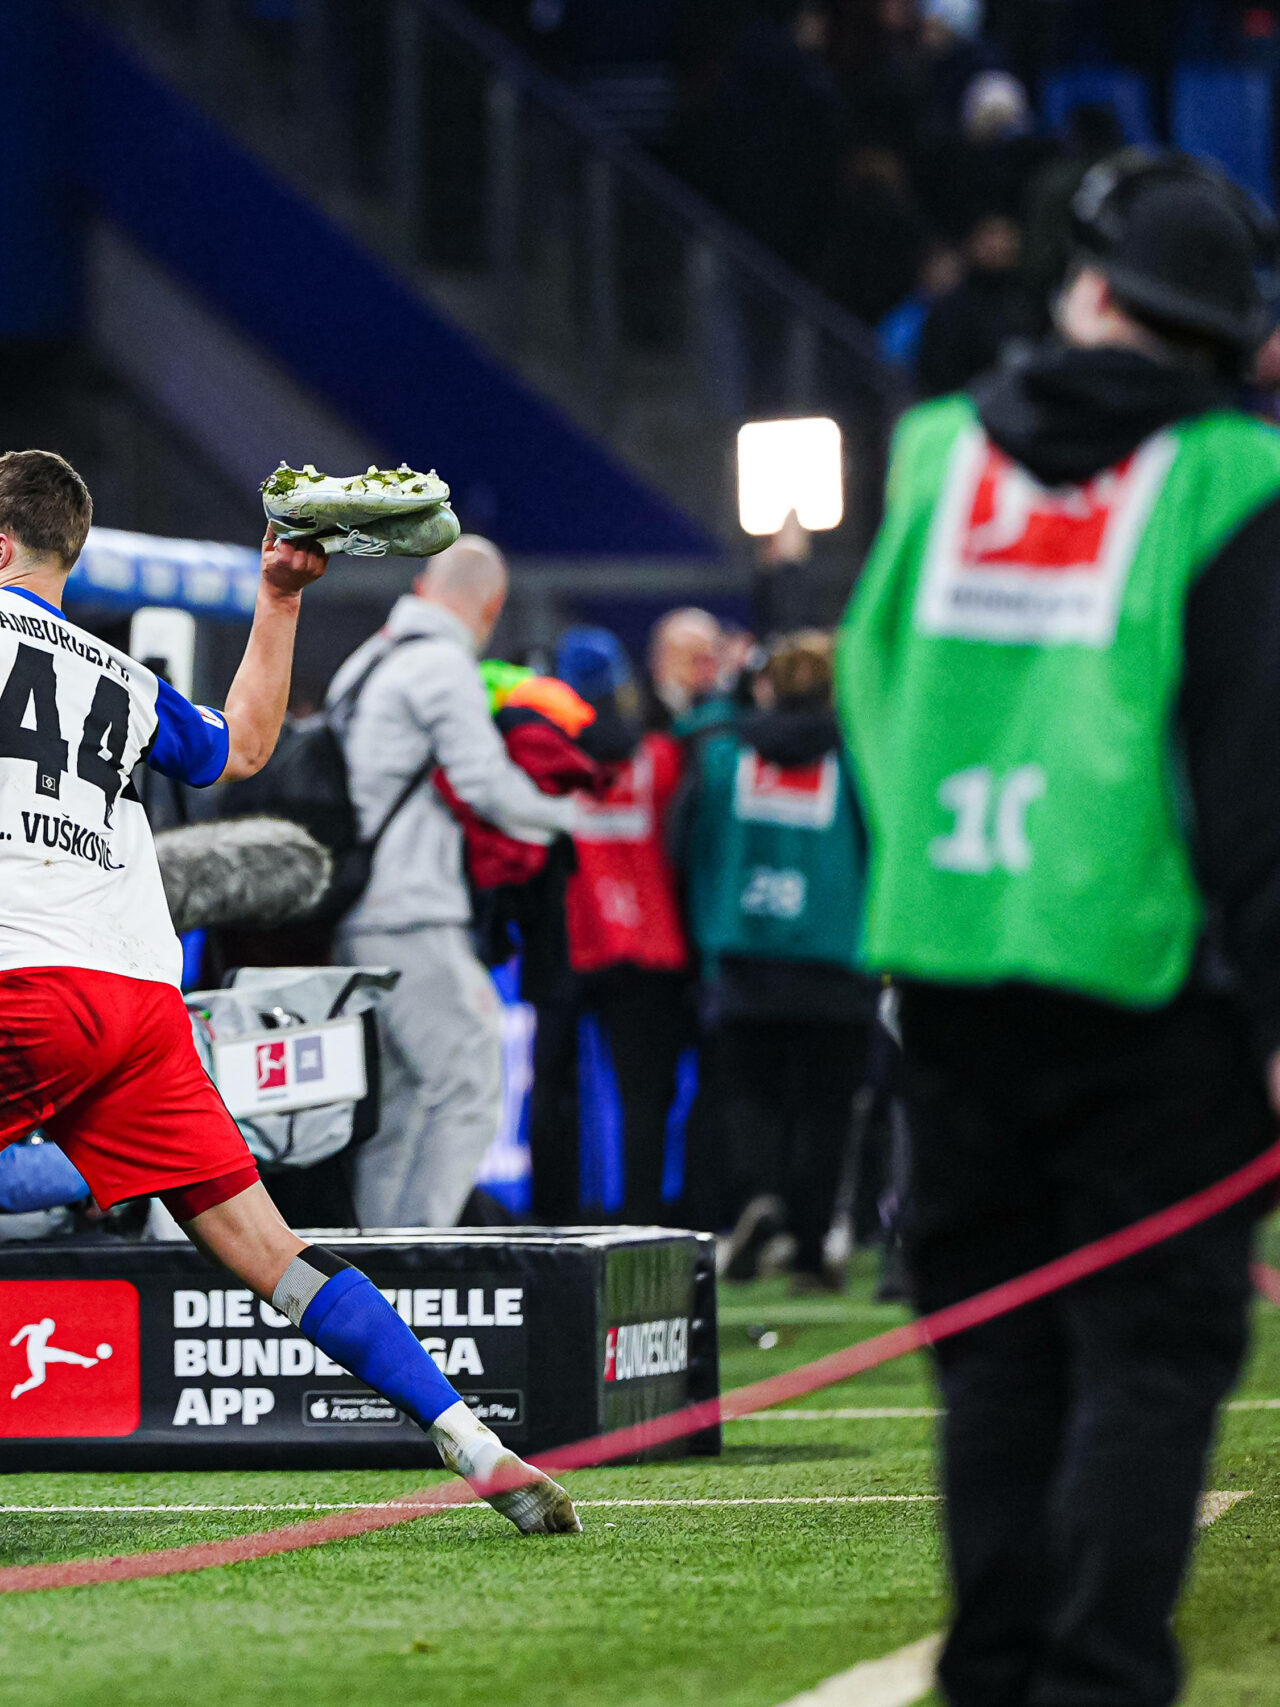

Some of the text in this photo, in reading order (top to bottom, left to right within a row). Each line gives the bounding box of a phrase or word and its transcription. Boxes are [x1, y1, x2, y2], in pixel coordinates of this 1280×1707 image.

[173, 1289, 255, 1329] DIE
[173, 1337, 485, 1377] BUNDEGA
[172, 1387, 276, 1426] APP
